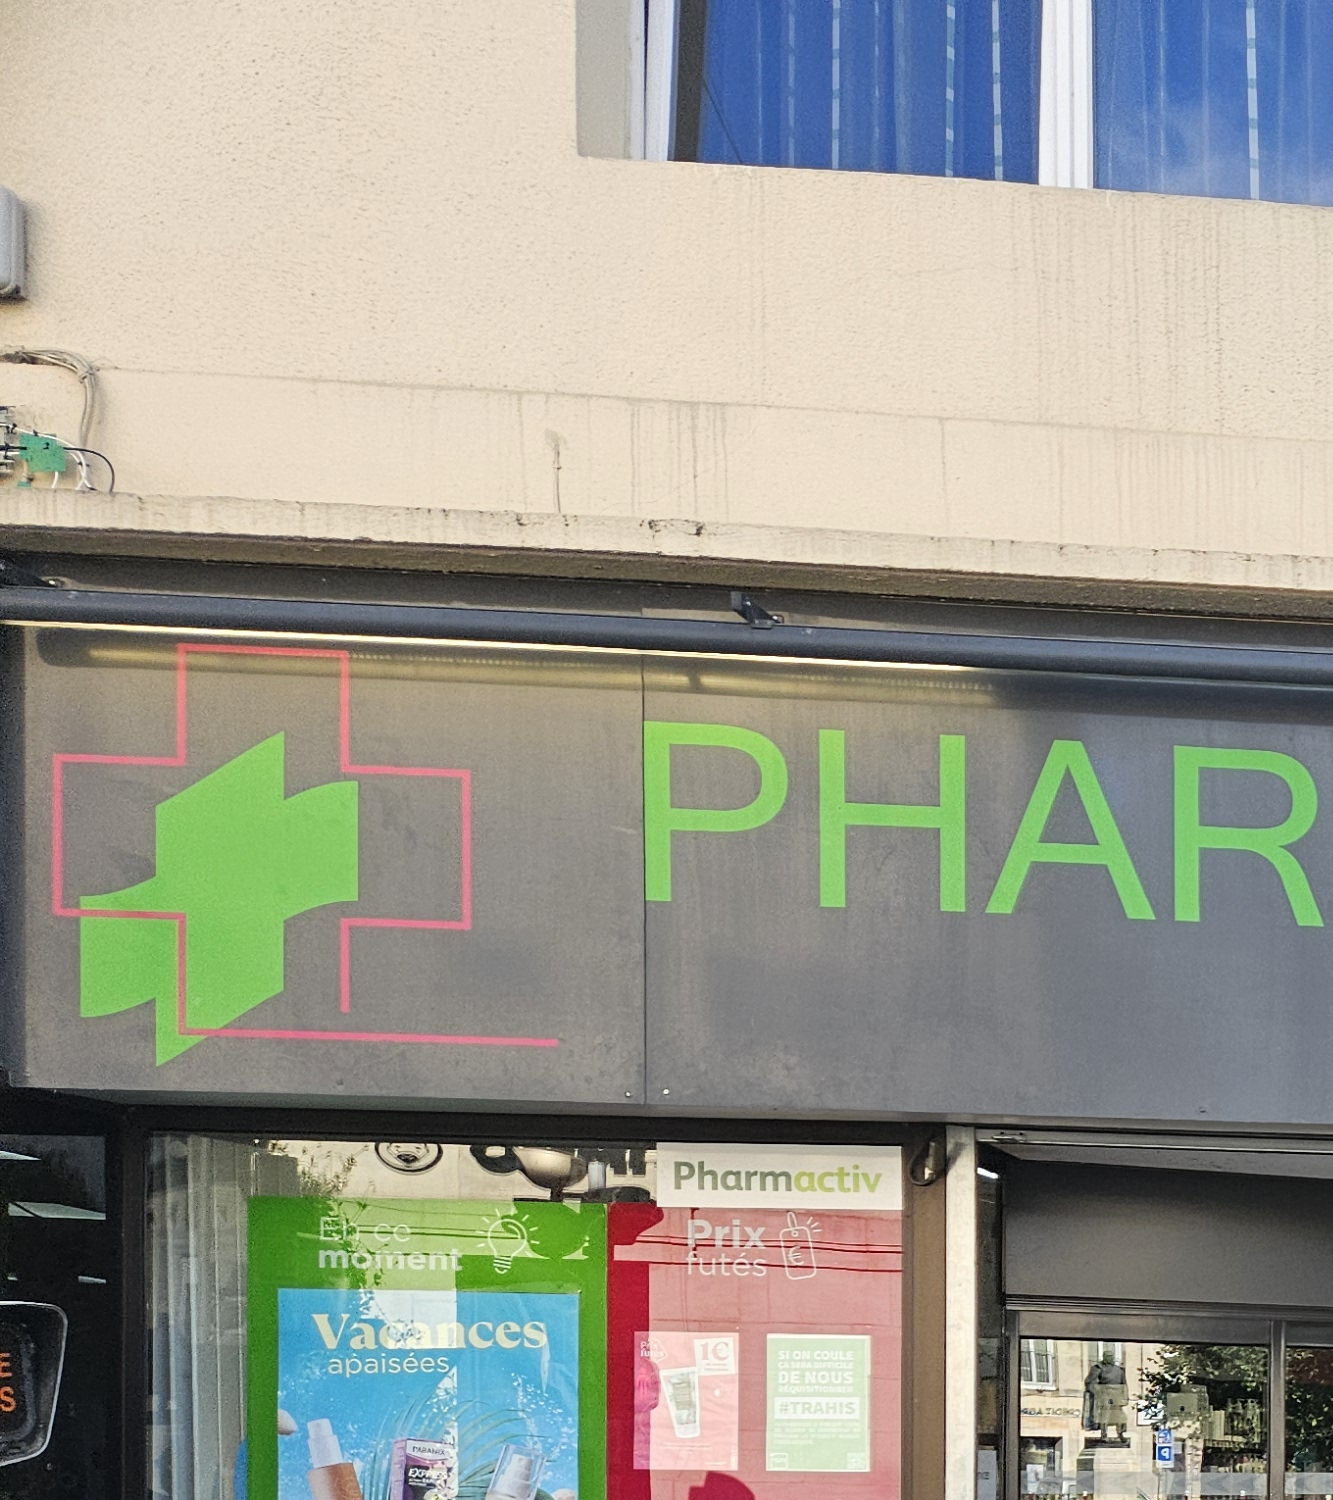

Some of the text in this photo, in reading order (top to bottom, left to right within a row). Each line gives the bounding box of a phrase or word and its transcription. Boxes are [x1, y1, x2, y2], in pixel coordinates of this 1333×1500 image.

[674, 1160, 883, 1193] Pharmactiv
[687, 1219, 766, 1249] Prix
[319, 1248, 462, 1271] moment
[685, 1253, 767, 1277] futés
[312, 1313, 549, 1350] Vacances
[327, 1353, 451, 1375] apaisées
[778, 1350, 854, 1361] SI ON COULE
[778, 1371, 854, 1384] DE NOUS
[779, 1401, 856, 1415] #TRAHIS
